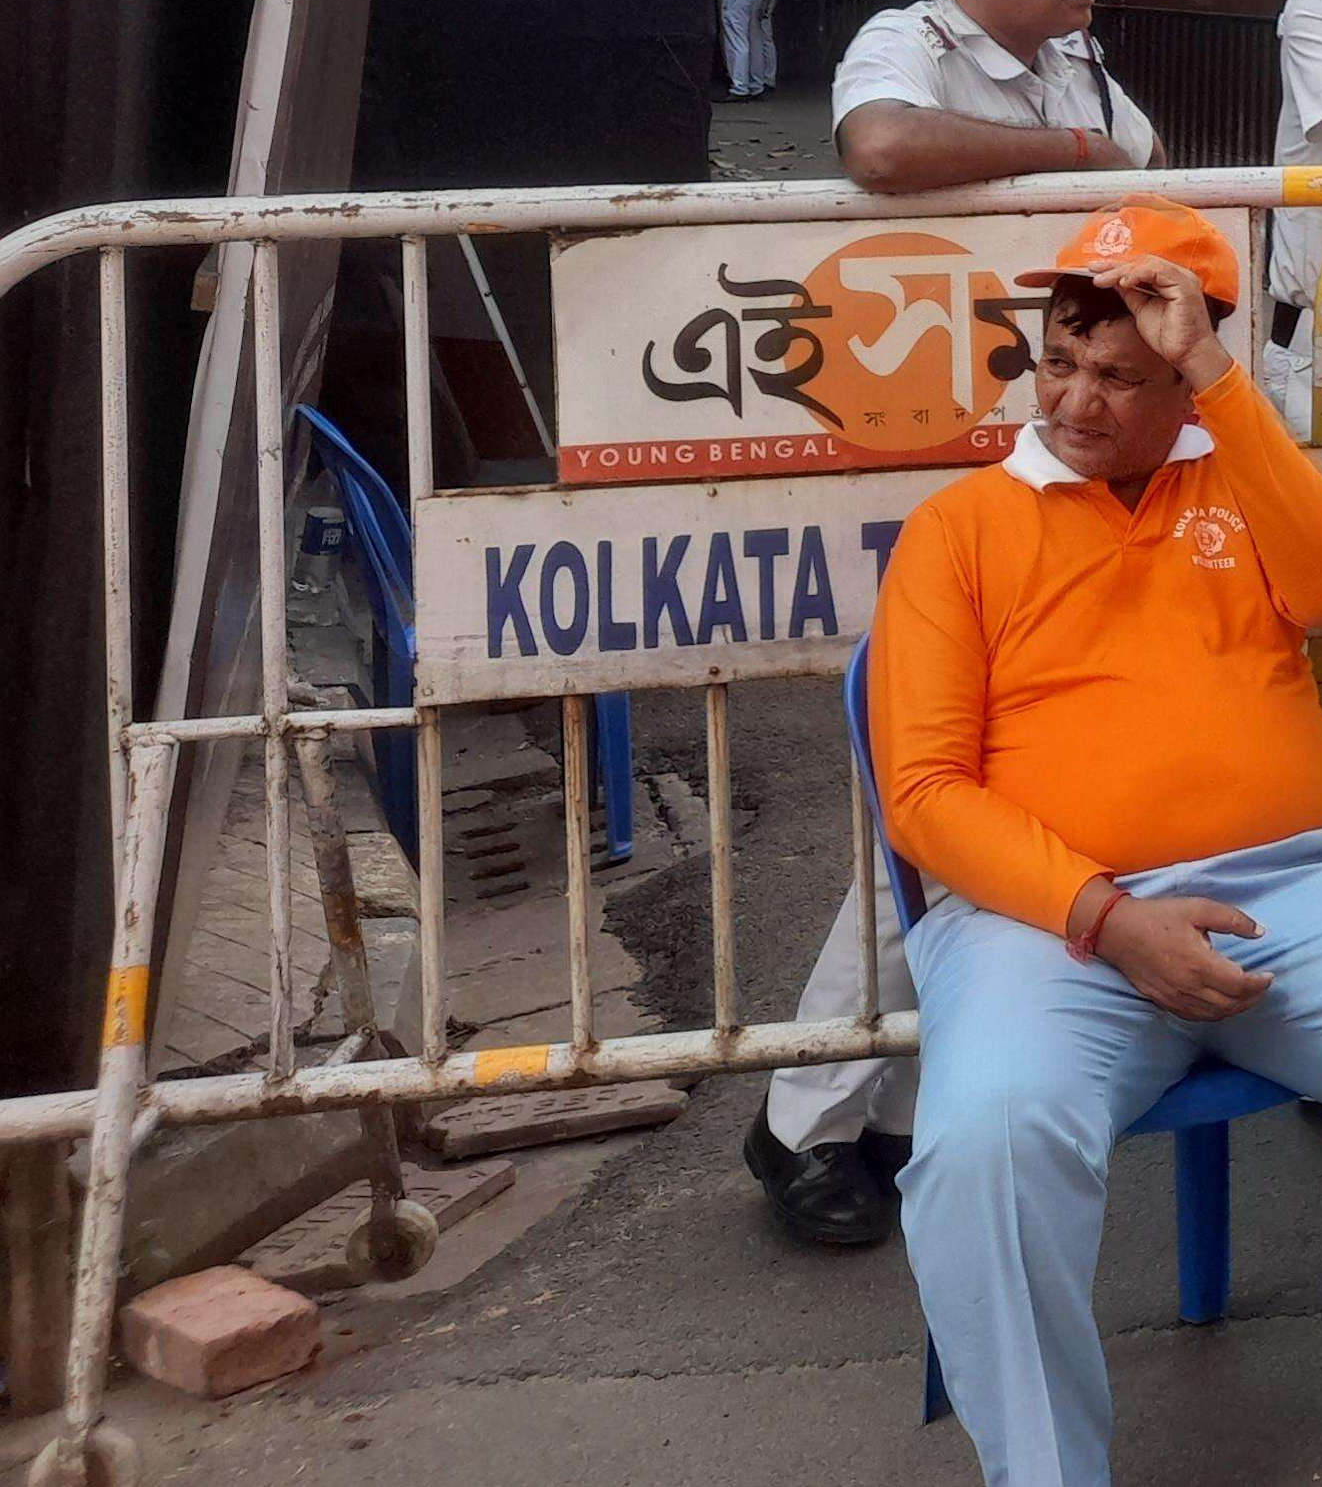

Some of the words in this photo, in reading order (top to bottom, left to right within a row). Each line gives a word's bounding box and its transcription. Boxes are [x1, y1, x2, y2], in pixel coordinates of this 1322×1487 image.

[642, 262, 845, 431] এই
[576, 442, 697, 469] YOUNG
[708, 437, 839, 462] BENGAL
[1208, 505, 1247, 533] POLICE
[484, 523, 838, 659] KOLKATA
